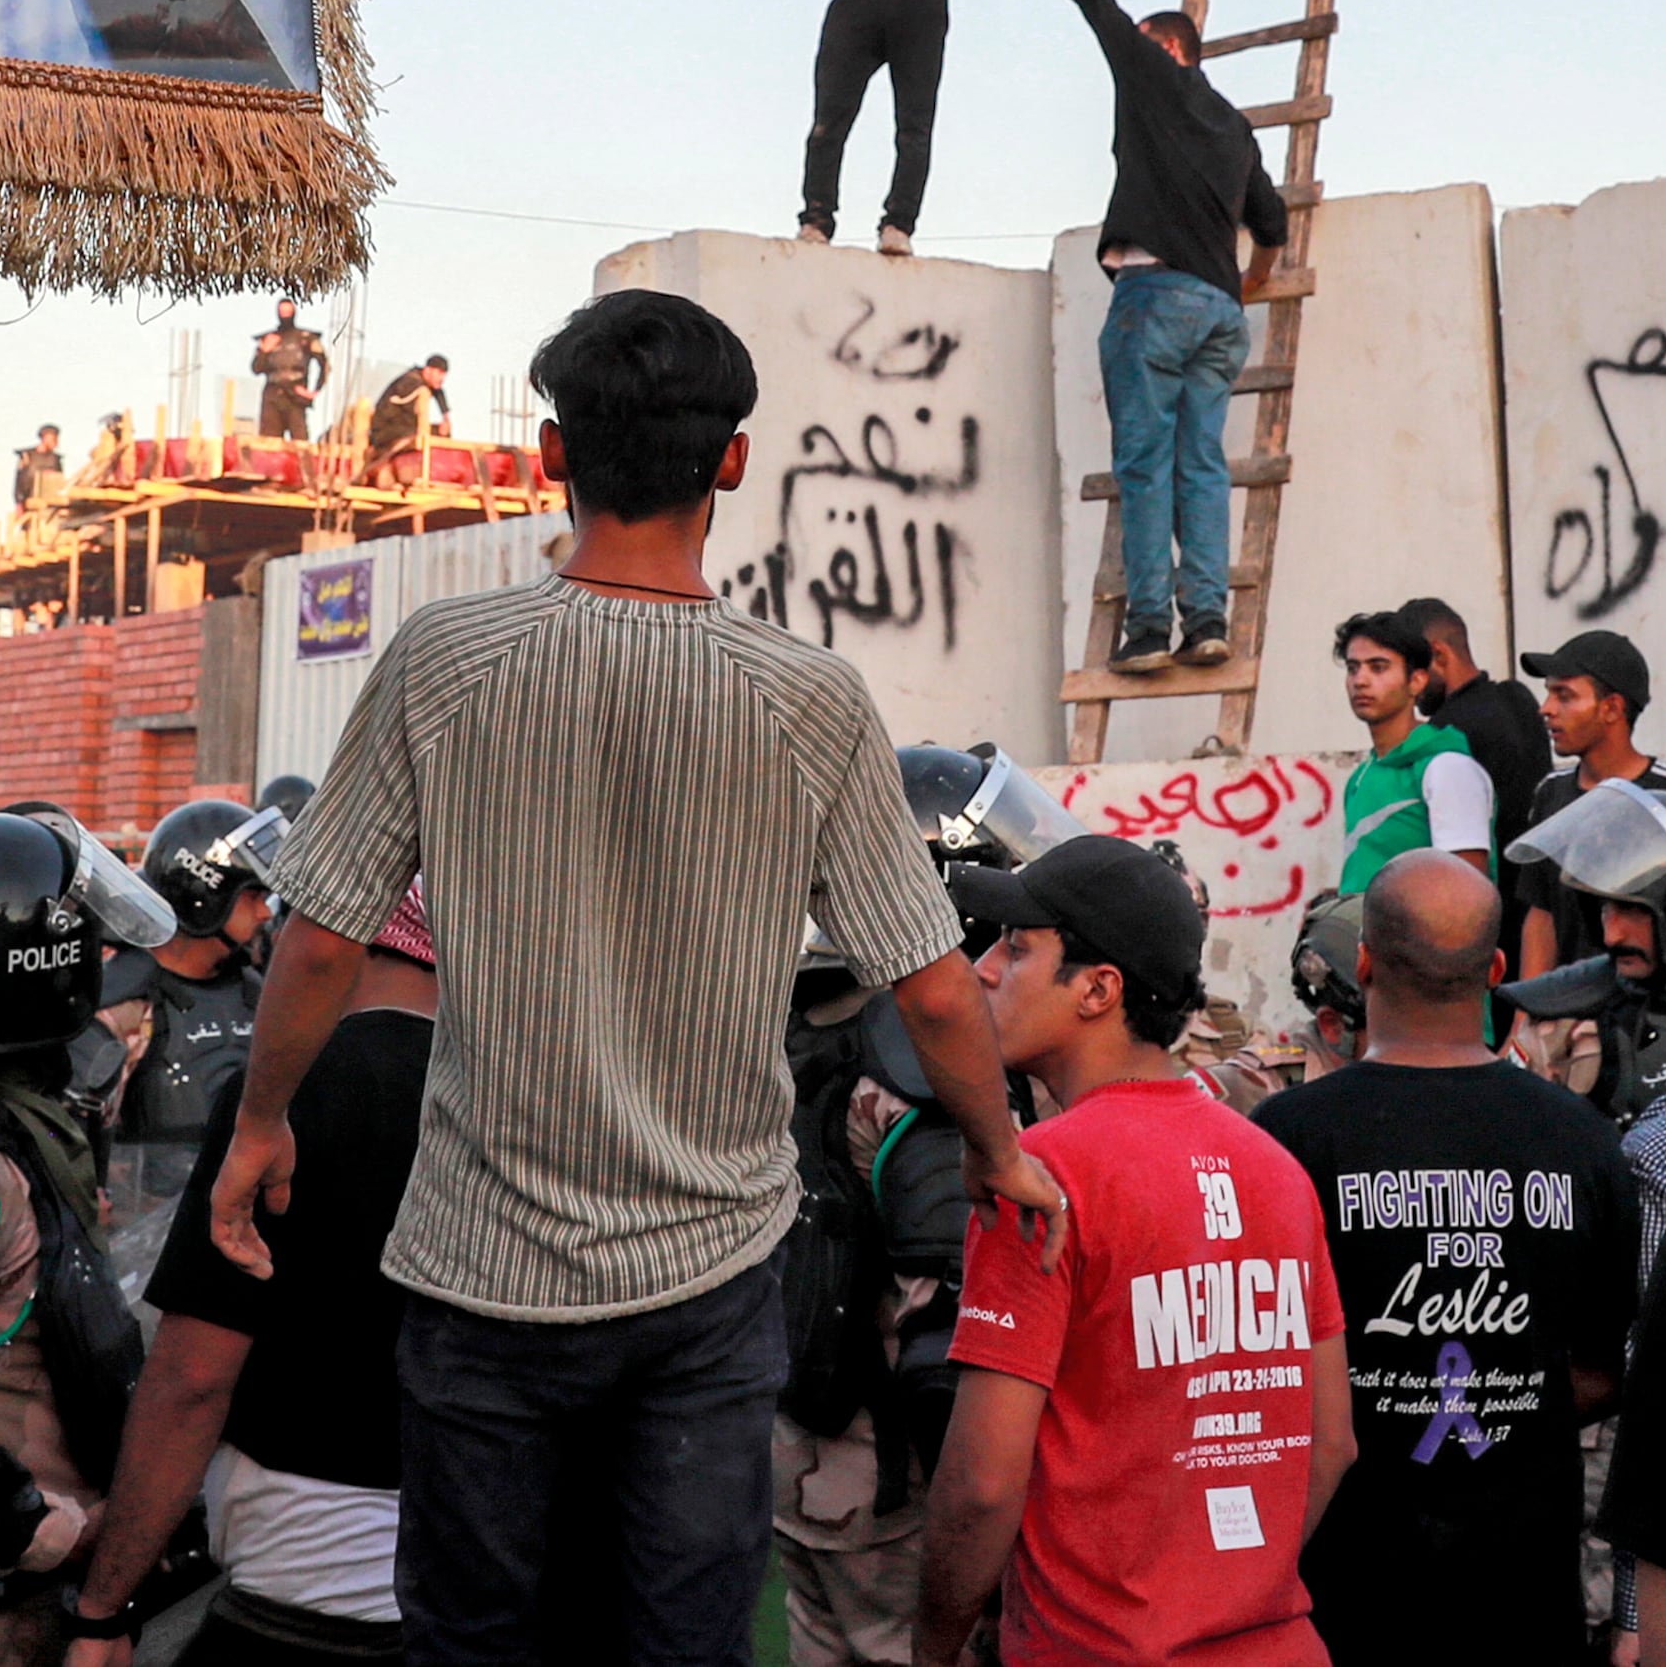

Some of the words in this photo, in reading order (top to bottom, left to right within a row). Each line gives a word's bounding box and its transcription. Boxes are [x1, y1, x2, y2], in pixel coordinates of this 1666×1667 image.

[173, 847, 225, 890] POLICE
[7, 940, 82, 974] POLICE
[1191, 1155, 1230, 1170] AVON
[1196, 1171, 1243, 1241] 39
[1337, 1168, 1514, 1231] FIGHTING
[1524, 1170, 1574, 1230] ON
[1427, 1232, 1505, 1269] FOR
[1131, 1257, 1312, 1369] MEDICA
[1364, 1262, 1530, 1337] Leslie
[1383, 1371, 1397, 1387] it
[1399, 1370, 1427, 1389] does
[1429, 1372, 1448, 1389] not
[1449, 1370, 1483, 1388] make
[1484, 1367, 1525, 1391] things
[1376, 1396, 1392, 1412] it
[1394, 1395, 1439, 1414] makes
[1444, 1395, 1478, 1414] them
[1481, 1391, 1541, 1418] possible
[1209, 1455, 1237, 1467] YOUR
[1238, 1451, 1282, 1465] DOCTOR.
[1257, 1438, 1285, 1450] YOUR
